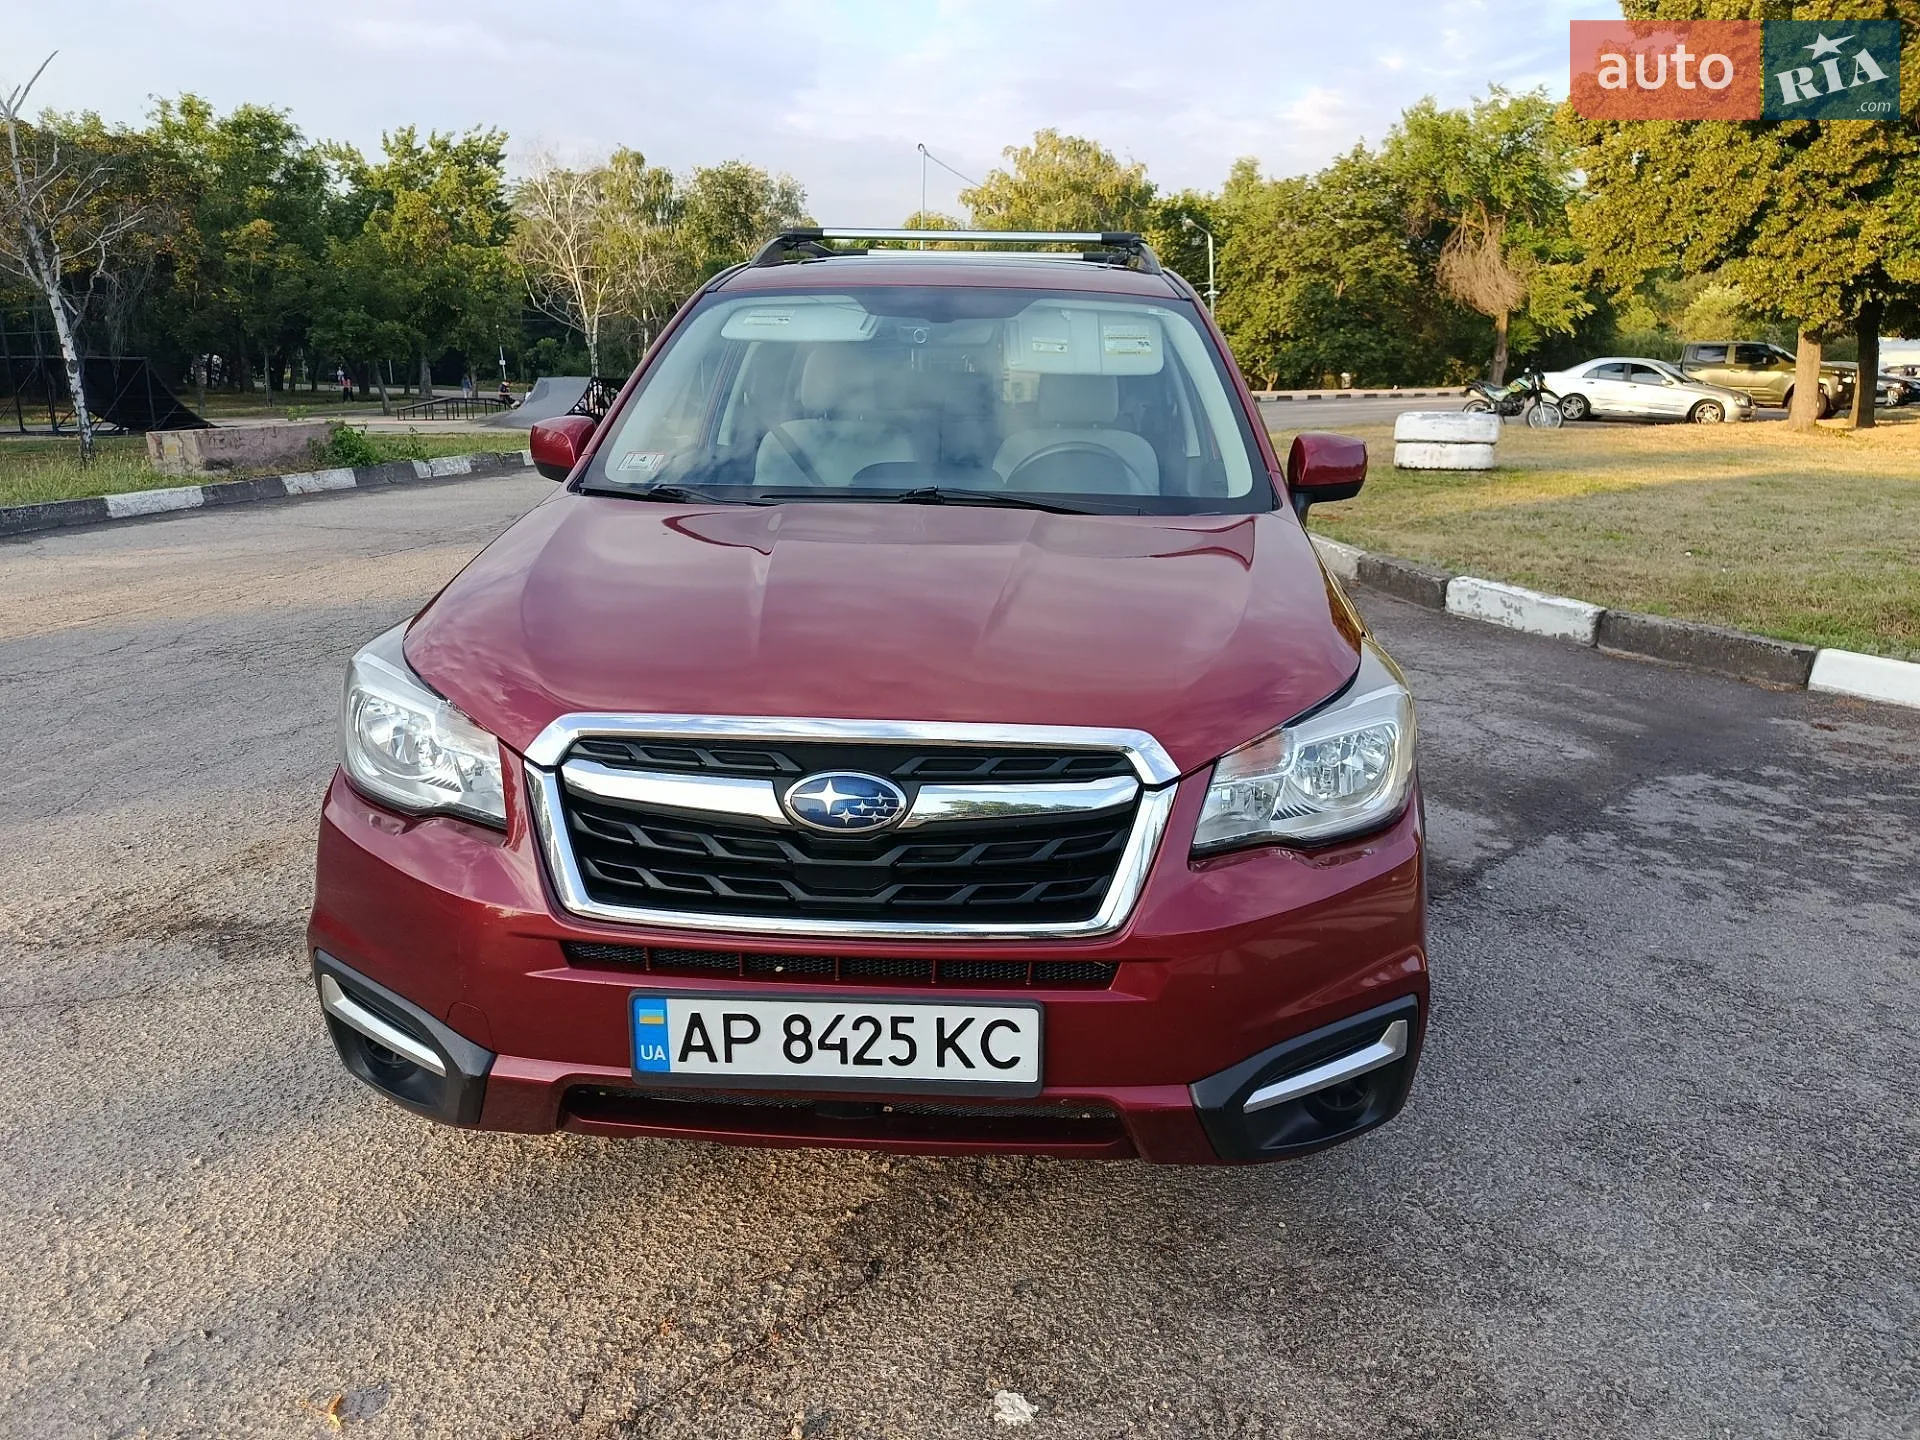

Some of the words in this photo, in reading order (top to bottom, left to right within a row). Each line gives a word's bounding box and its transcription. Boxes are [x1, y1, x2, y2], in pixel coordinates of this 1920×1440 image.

[640, 1045, 667, 1061] UA
[677, 1012, 761, 1064] AP
[782, 1013, 918, 1067] 8425
[935, 1016, 1022, 1070] KC
